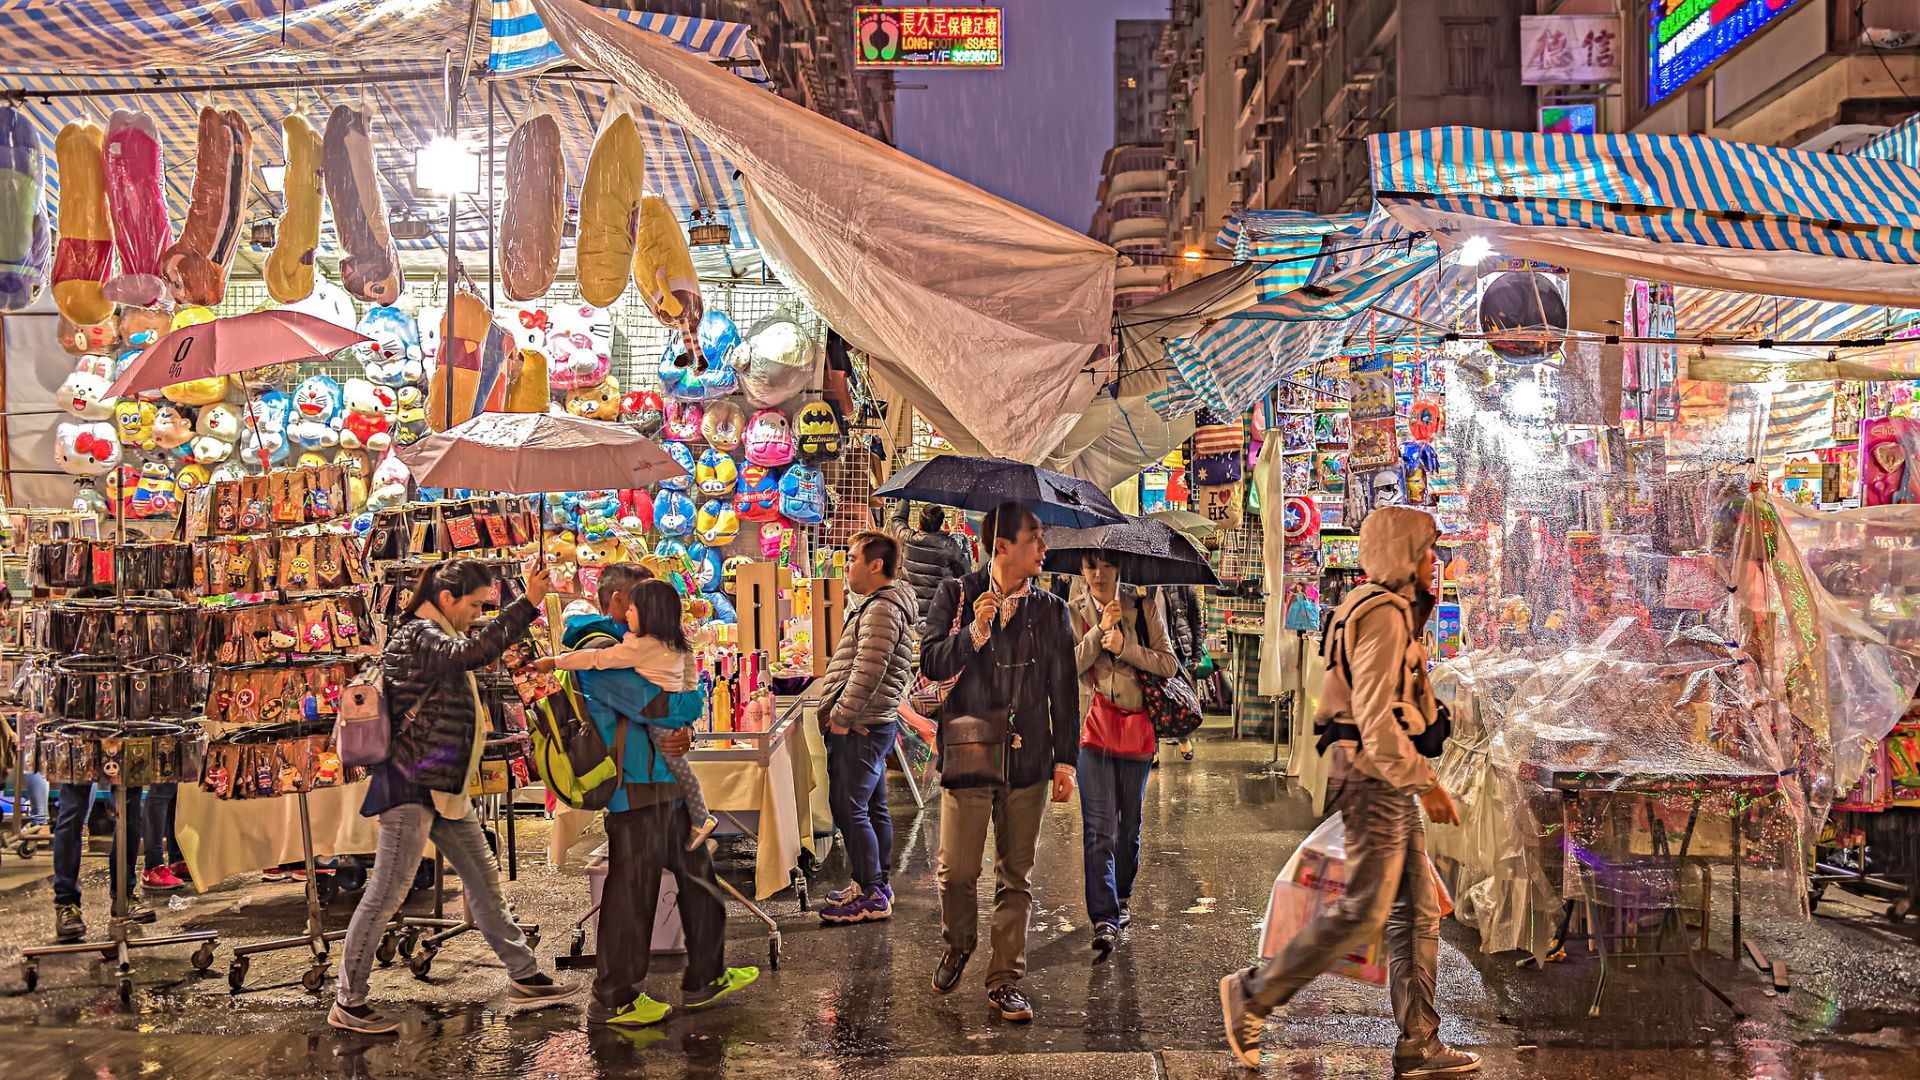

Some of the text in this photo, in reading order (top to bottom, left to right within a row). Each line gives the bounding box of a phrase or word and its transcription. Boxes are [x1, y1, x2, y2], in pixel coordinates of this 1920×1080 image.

[902, 37, 928, 50] LONG
[1208, 491, 1218, 506] I
[1208, 505, 1229, 520] HK
